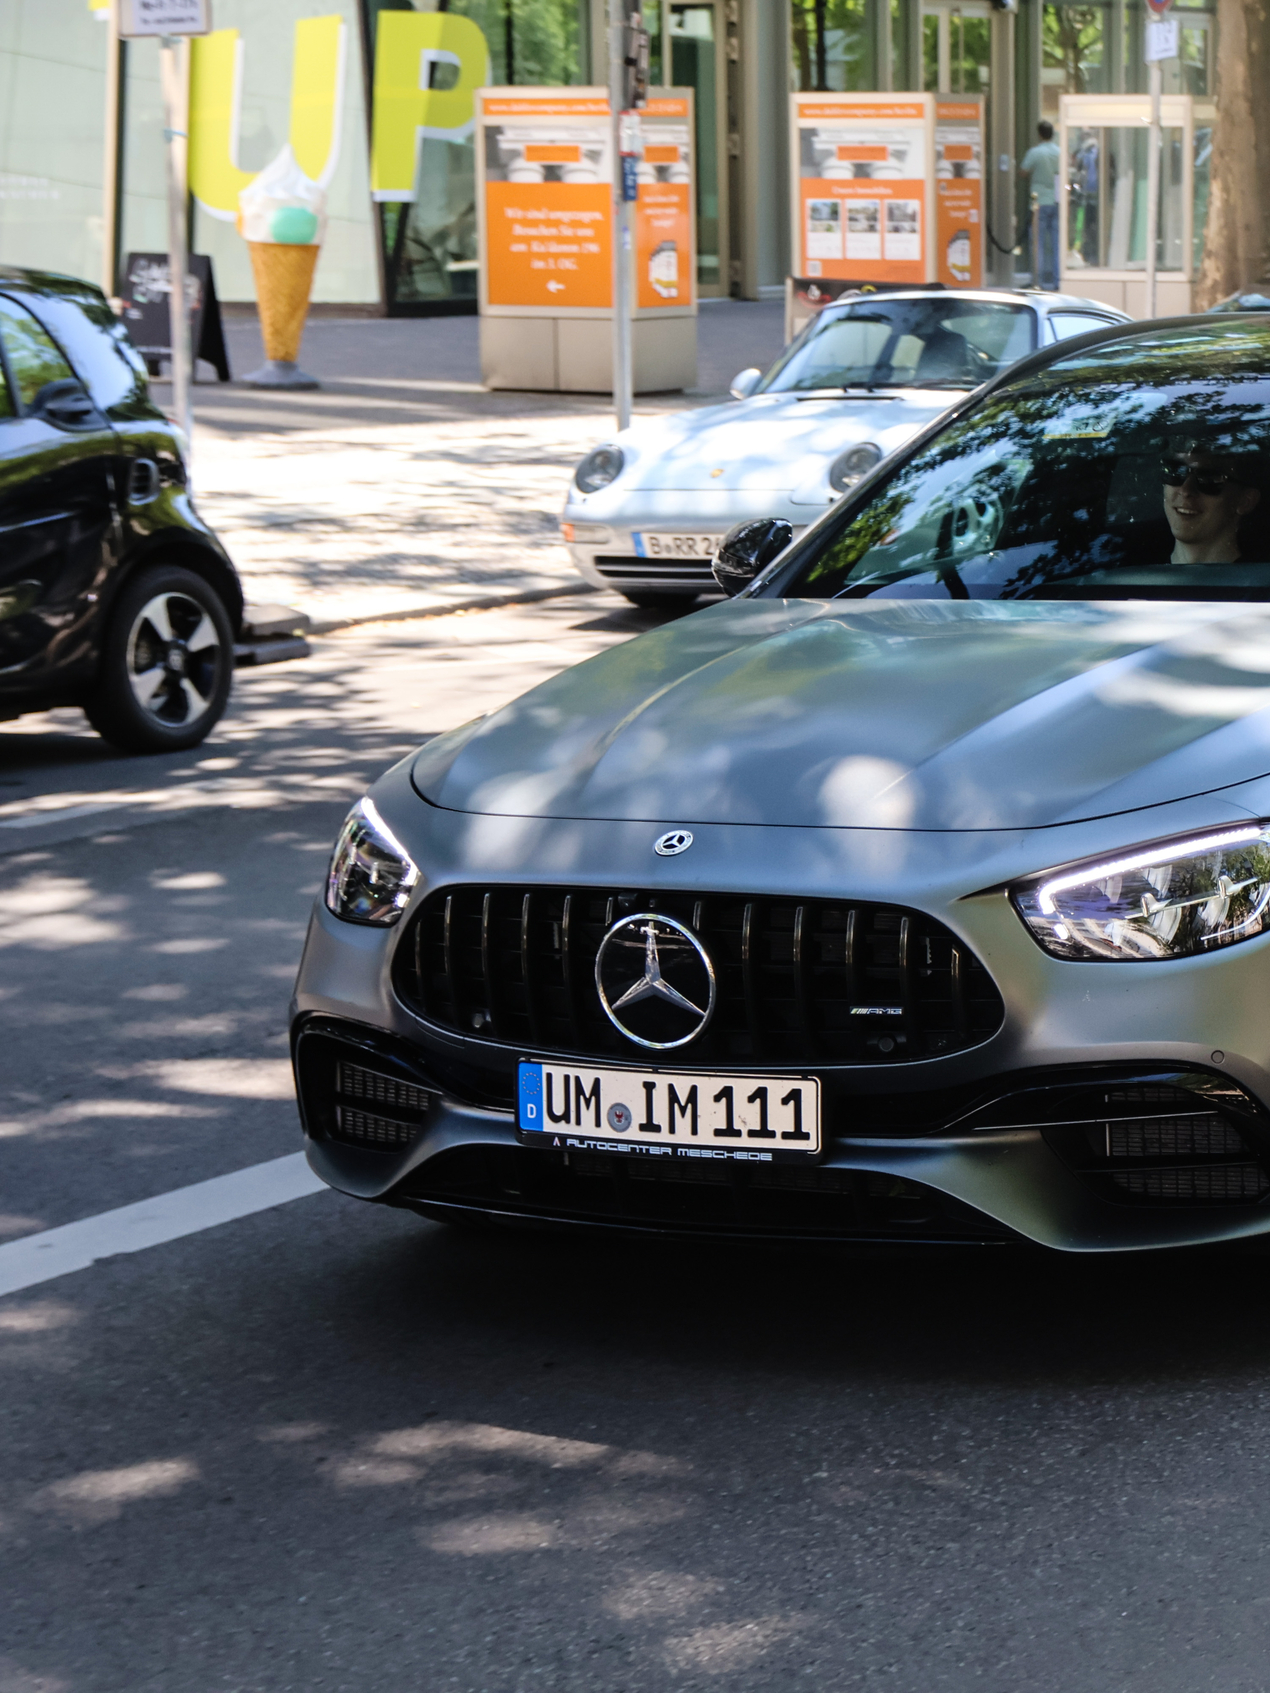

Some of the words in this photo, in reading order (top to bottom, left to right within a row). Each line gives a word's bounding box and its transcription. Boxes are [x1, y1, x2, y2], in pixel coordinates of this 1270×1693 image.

[649, 536, 660, 555] B
[673, 537, 698, 556] RR
[527, 1103, 537, 1118] D
[546, 1072, 601, 1128] UM
[638, 1081, 699, 1136] IM
[713, 1085, 811, 1141] 111
[566, 1138, 672, 1155] AUTOCENTER
[677, 1147, 773, 1161] MESCHEDE
